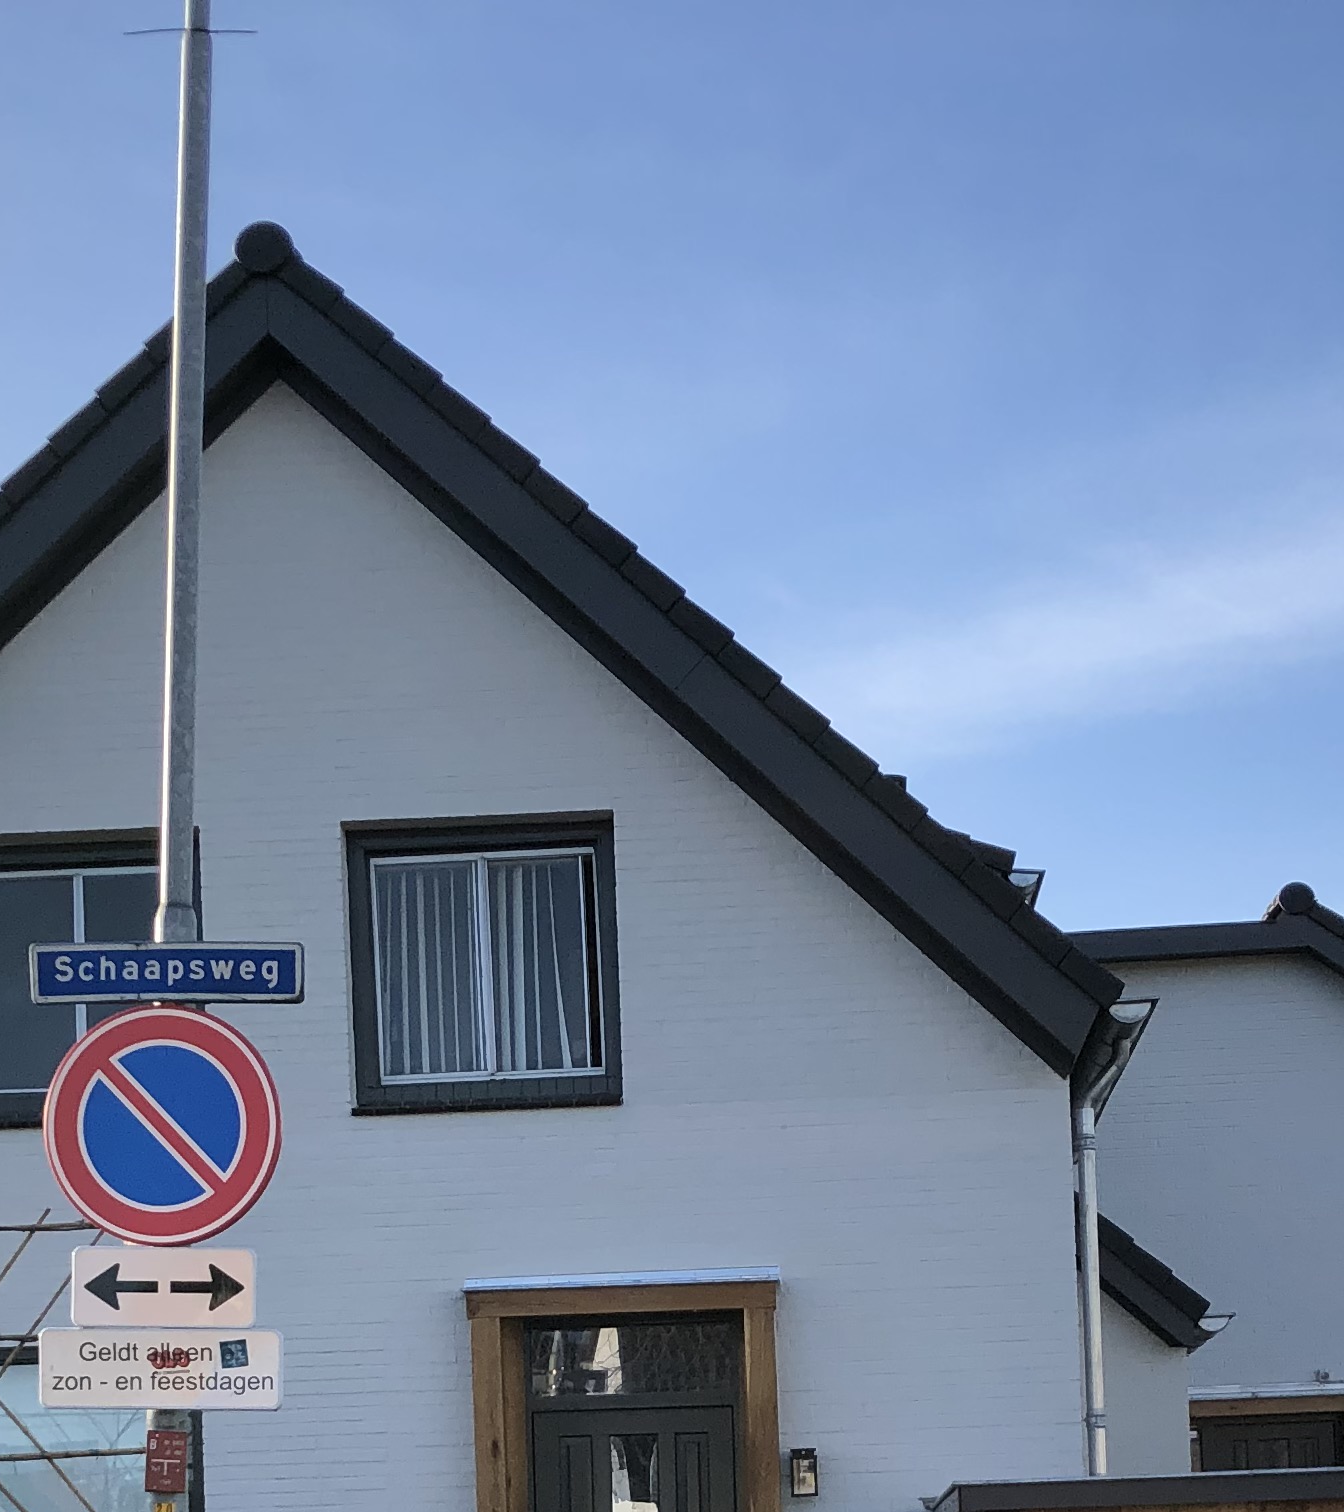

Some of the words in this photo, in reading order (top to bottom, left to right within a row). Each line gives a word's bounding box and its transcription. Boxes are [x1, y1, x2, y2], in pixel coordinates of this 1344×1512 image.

[54, 955, 279, 989] Schaapsweg
[78, 1341, 139, 1362] Geldt
[52, 1374, 92, 1391] zon
[115, 1374, 142, 1391] en
[150, 1371, 274, 1396] feestdagen
